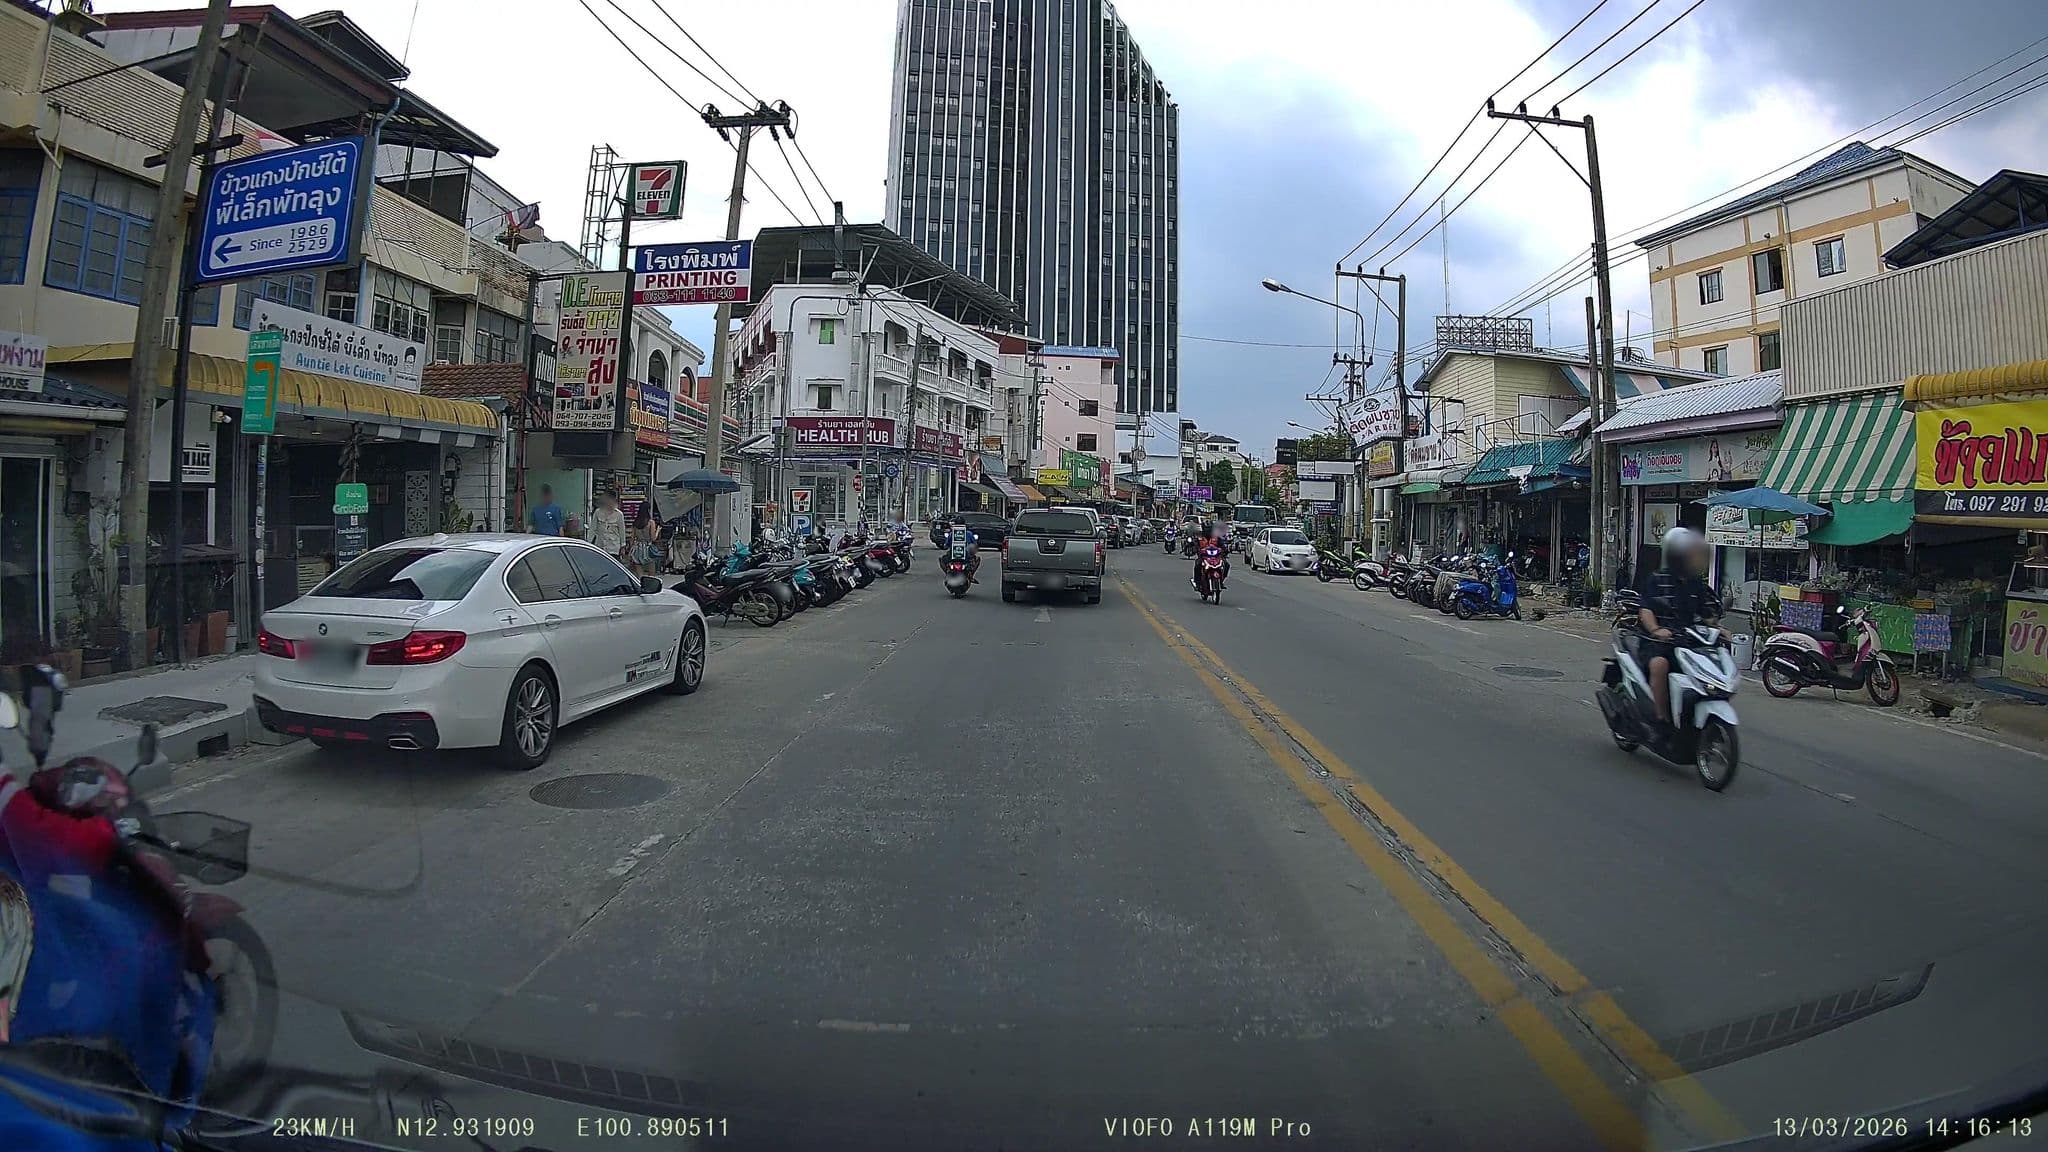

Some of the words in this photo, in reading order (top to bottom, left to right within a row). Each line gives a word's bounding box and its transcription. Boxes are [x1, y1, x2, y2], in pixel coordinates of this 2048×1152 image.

[220, 150, 347, 196] ข้าวแกงปักษ์ใต้
[640, 168, 672, 214] 7
[216, 187, 342, 225] พี่เล็กพัทลุง
[249, 236, 283, 252] Since
[290, 223, 328, 240] 1986
[288, 237, 327, 254] 2529
[644, 244, 742, 271] โรงพิมพ์
[645, 270, 737, 289] PRINTING
[701, 287, 736, 300] 1140
[586, 309, 621, 330] ขาย
[576, 331, 618, 355] จำนำ
[296, 353, 331, 371] Auntie
[334, 360, 350, 376] Lek
[353, 364, 386, 382] Cuisine
[817, 420, 843, 428] ร้านยา
[798, 429, 858, 443] HEALTH
[1943, 490, 1966, 512] โทร.
[1969, 495, 1994, 512] 097
[2000, 496, 2026, 513] 291
